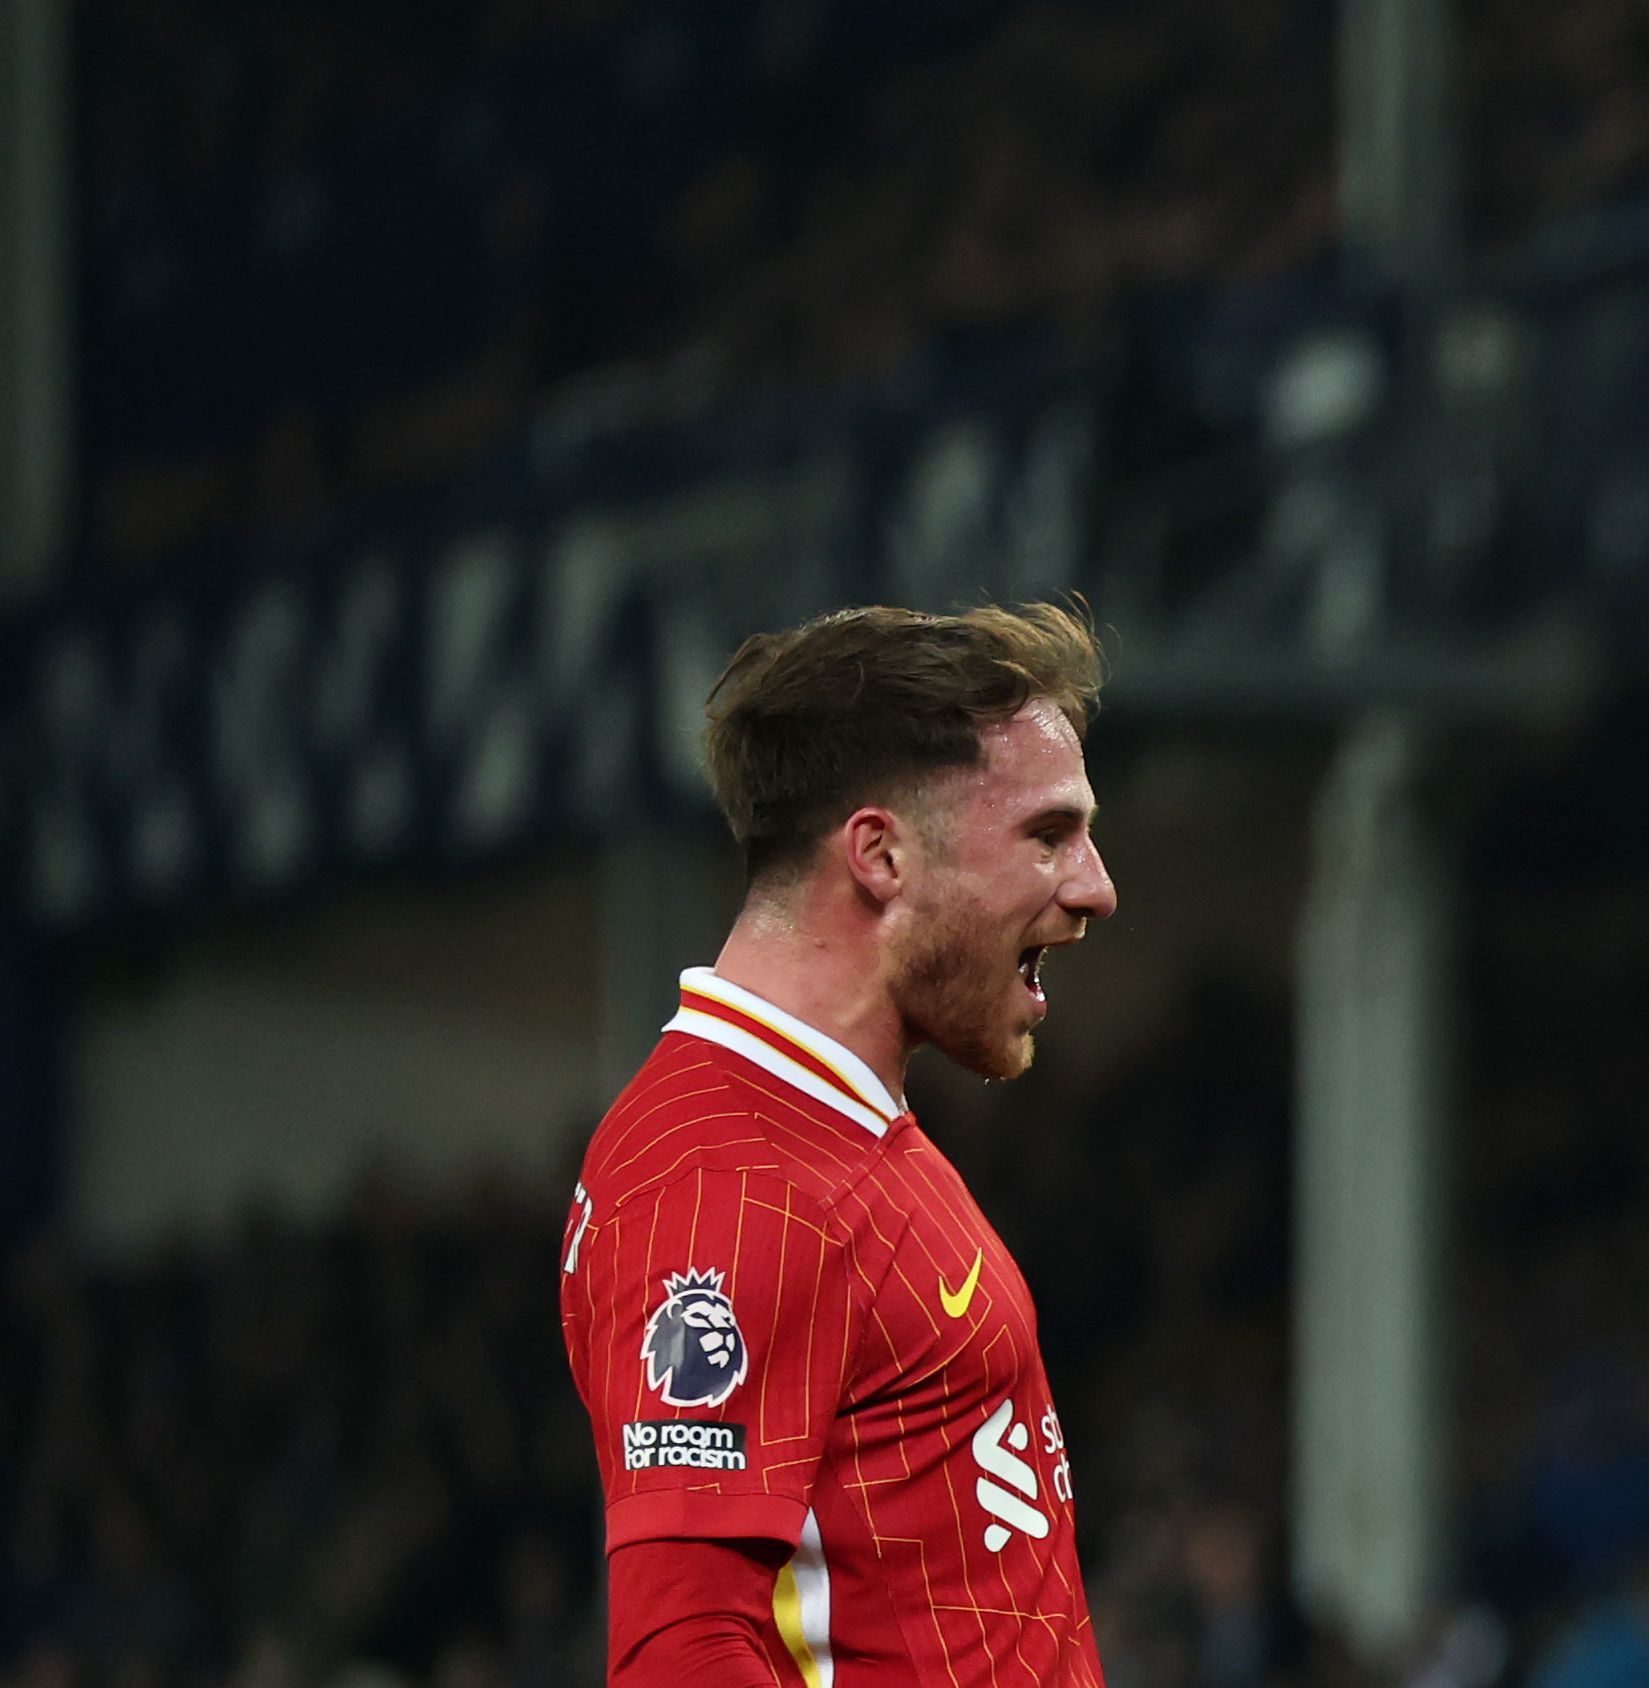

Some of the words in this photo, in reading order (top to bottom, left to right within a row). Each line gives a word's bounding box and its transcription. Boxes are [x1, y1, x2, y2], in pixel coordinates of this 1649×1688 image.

[622, 1422, 657, 1448] No
[661, 1424, 734, 1449] room
[624, 1446, 656, 1471] for
[658, 1446, 746, 1470] racism
